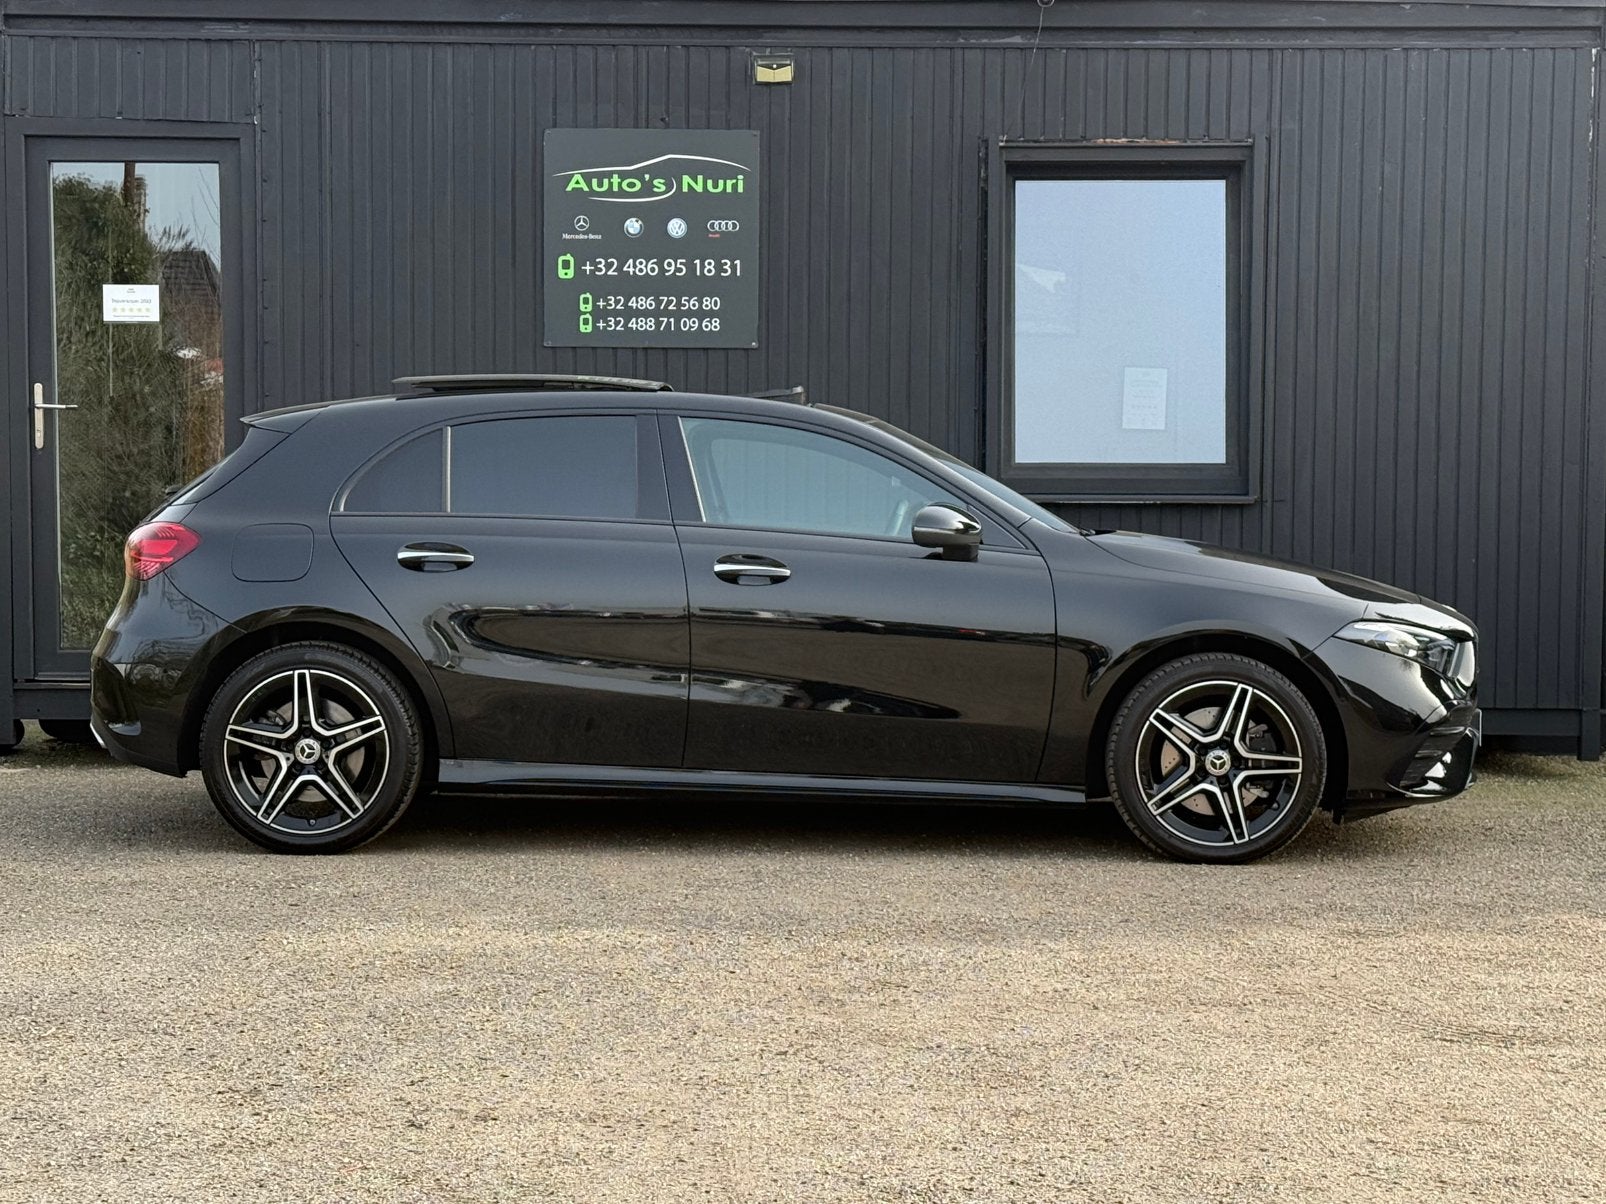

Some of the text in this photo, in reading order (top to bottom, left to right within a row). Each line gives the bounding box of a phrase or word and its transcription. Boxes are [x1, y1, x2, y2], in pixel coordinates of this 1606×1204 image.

[565, 173, 744, 193] Auto's Nuri
[581, 257, 742, 277] +32 486 95 18 31
[596, 295, 720, 311] +32 486 72 56 80
[596, 316, 720, 332] +32 488 71 09 68
